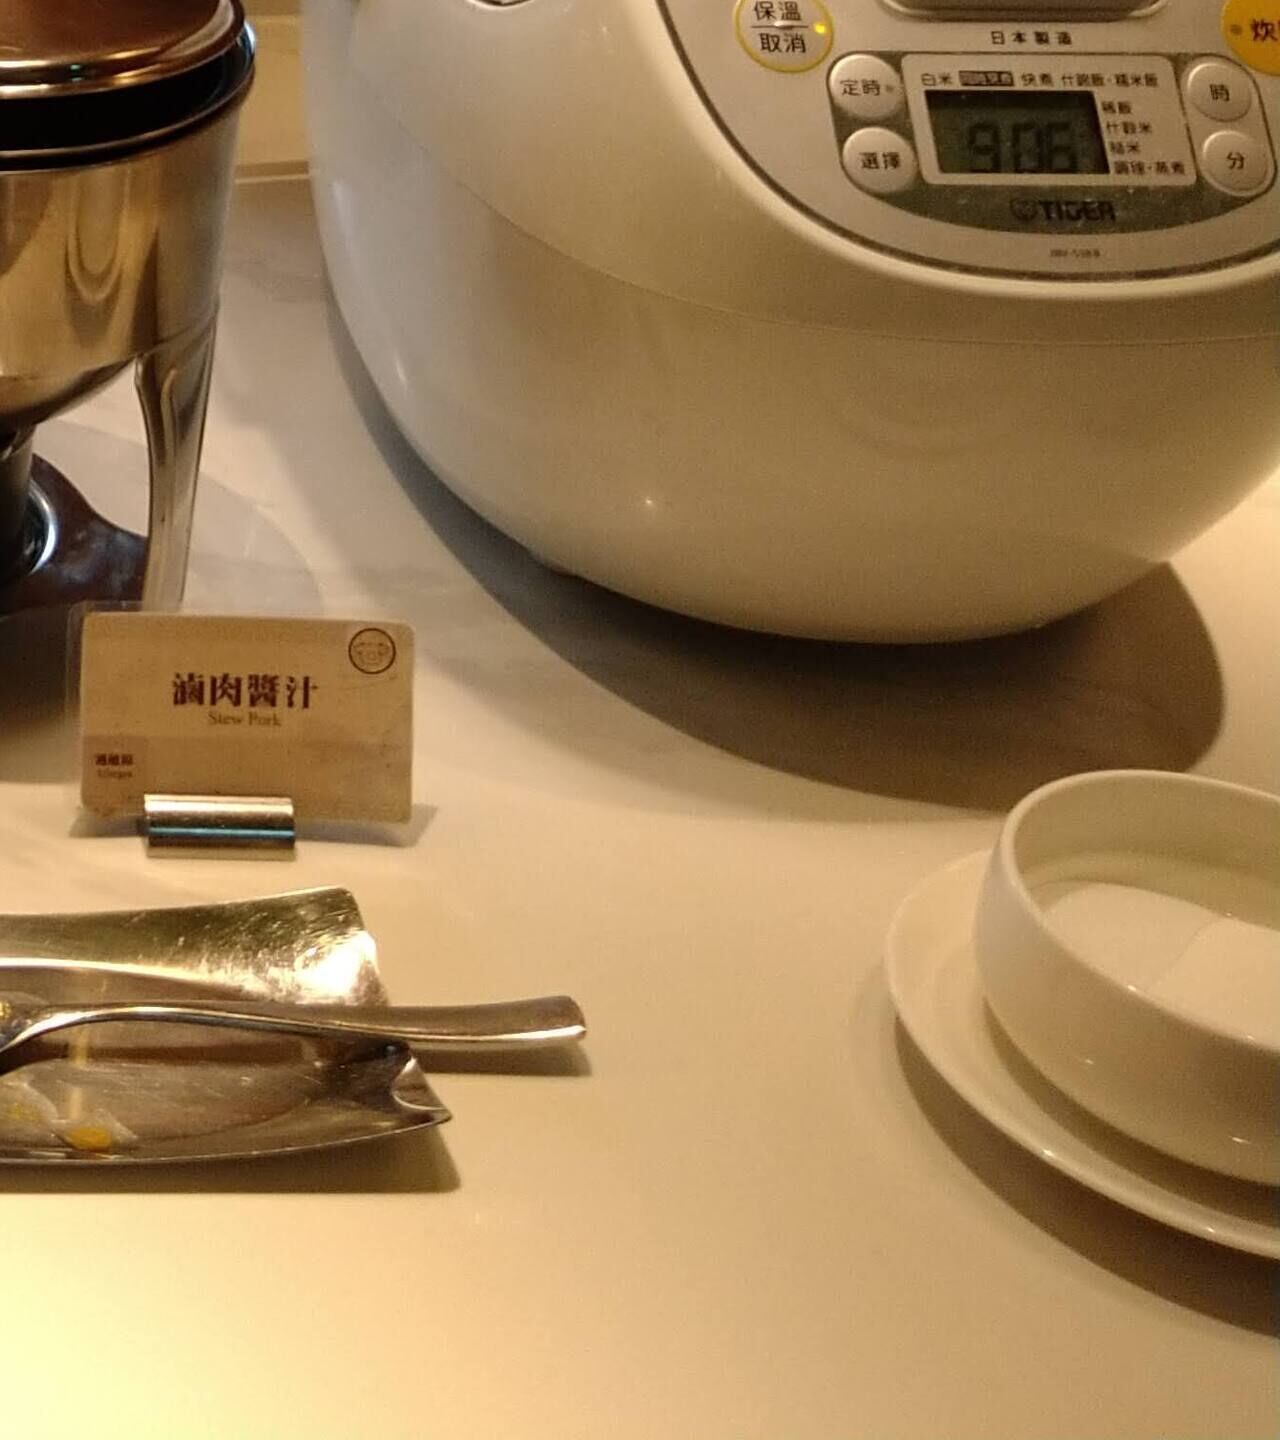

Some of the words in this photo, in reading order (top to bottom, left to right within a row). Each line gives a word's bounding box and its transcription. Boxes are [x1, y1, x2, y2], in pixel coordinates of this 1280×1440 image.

[753, 0, 802, 22] 保溫
[1250, 19, 1280, 42] 炊
[758, 33, 807, 54] 取消
[840, 79, 881, 97] 定時
[1226, 151, 1245, 170] 分
[1040, 199, 1116, 222] TIGER
[172, 672, 319, 710] 滷肉醬汁
[207, 711, 243, 727] Stew
[248, 712, 282, 727] Pork
